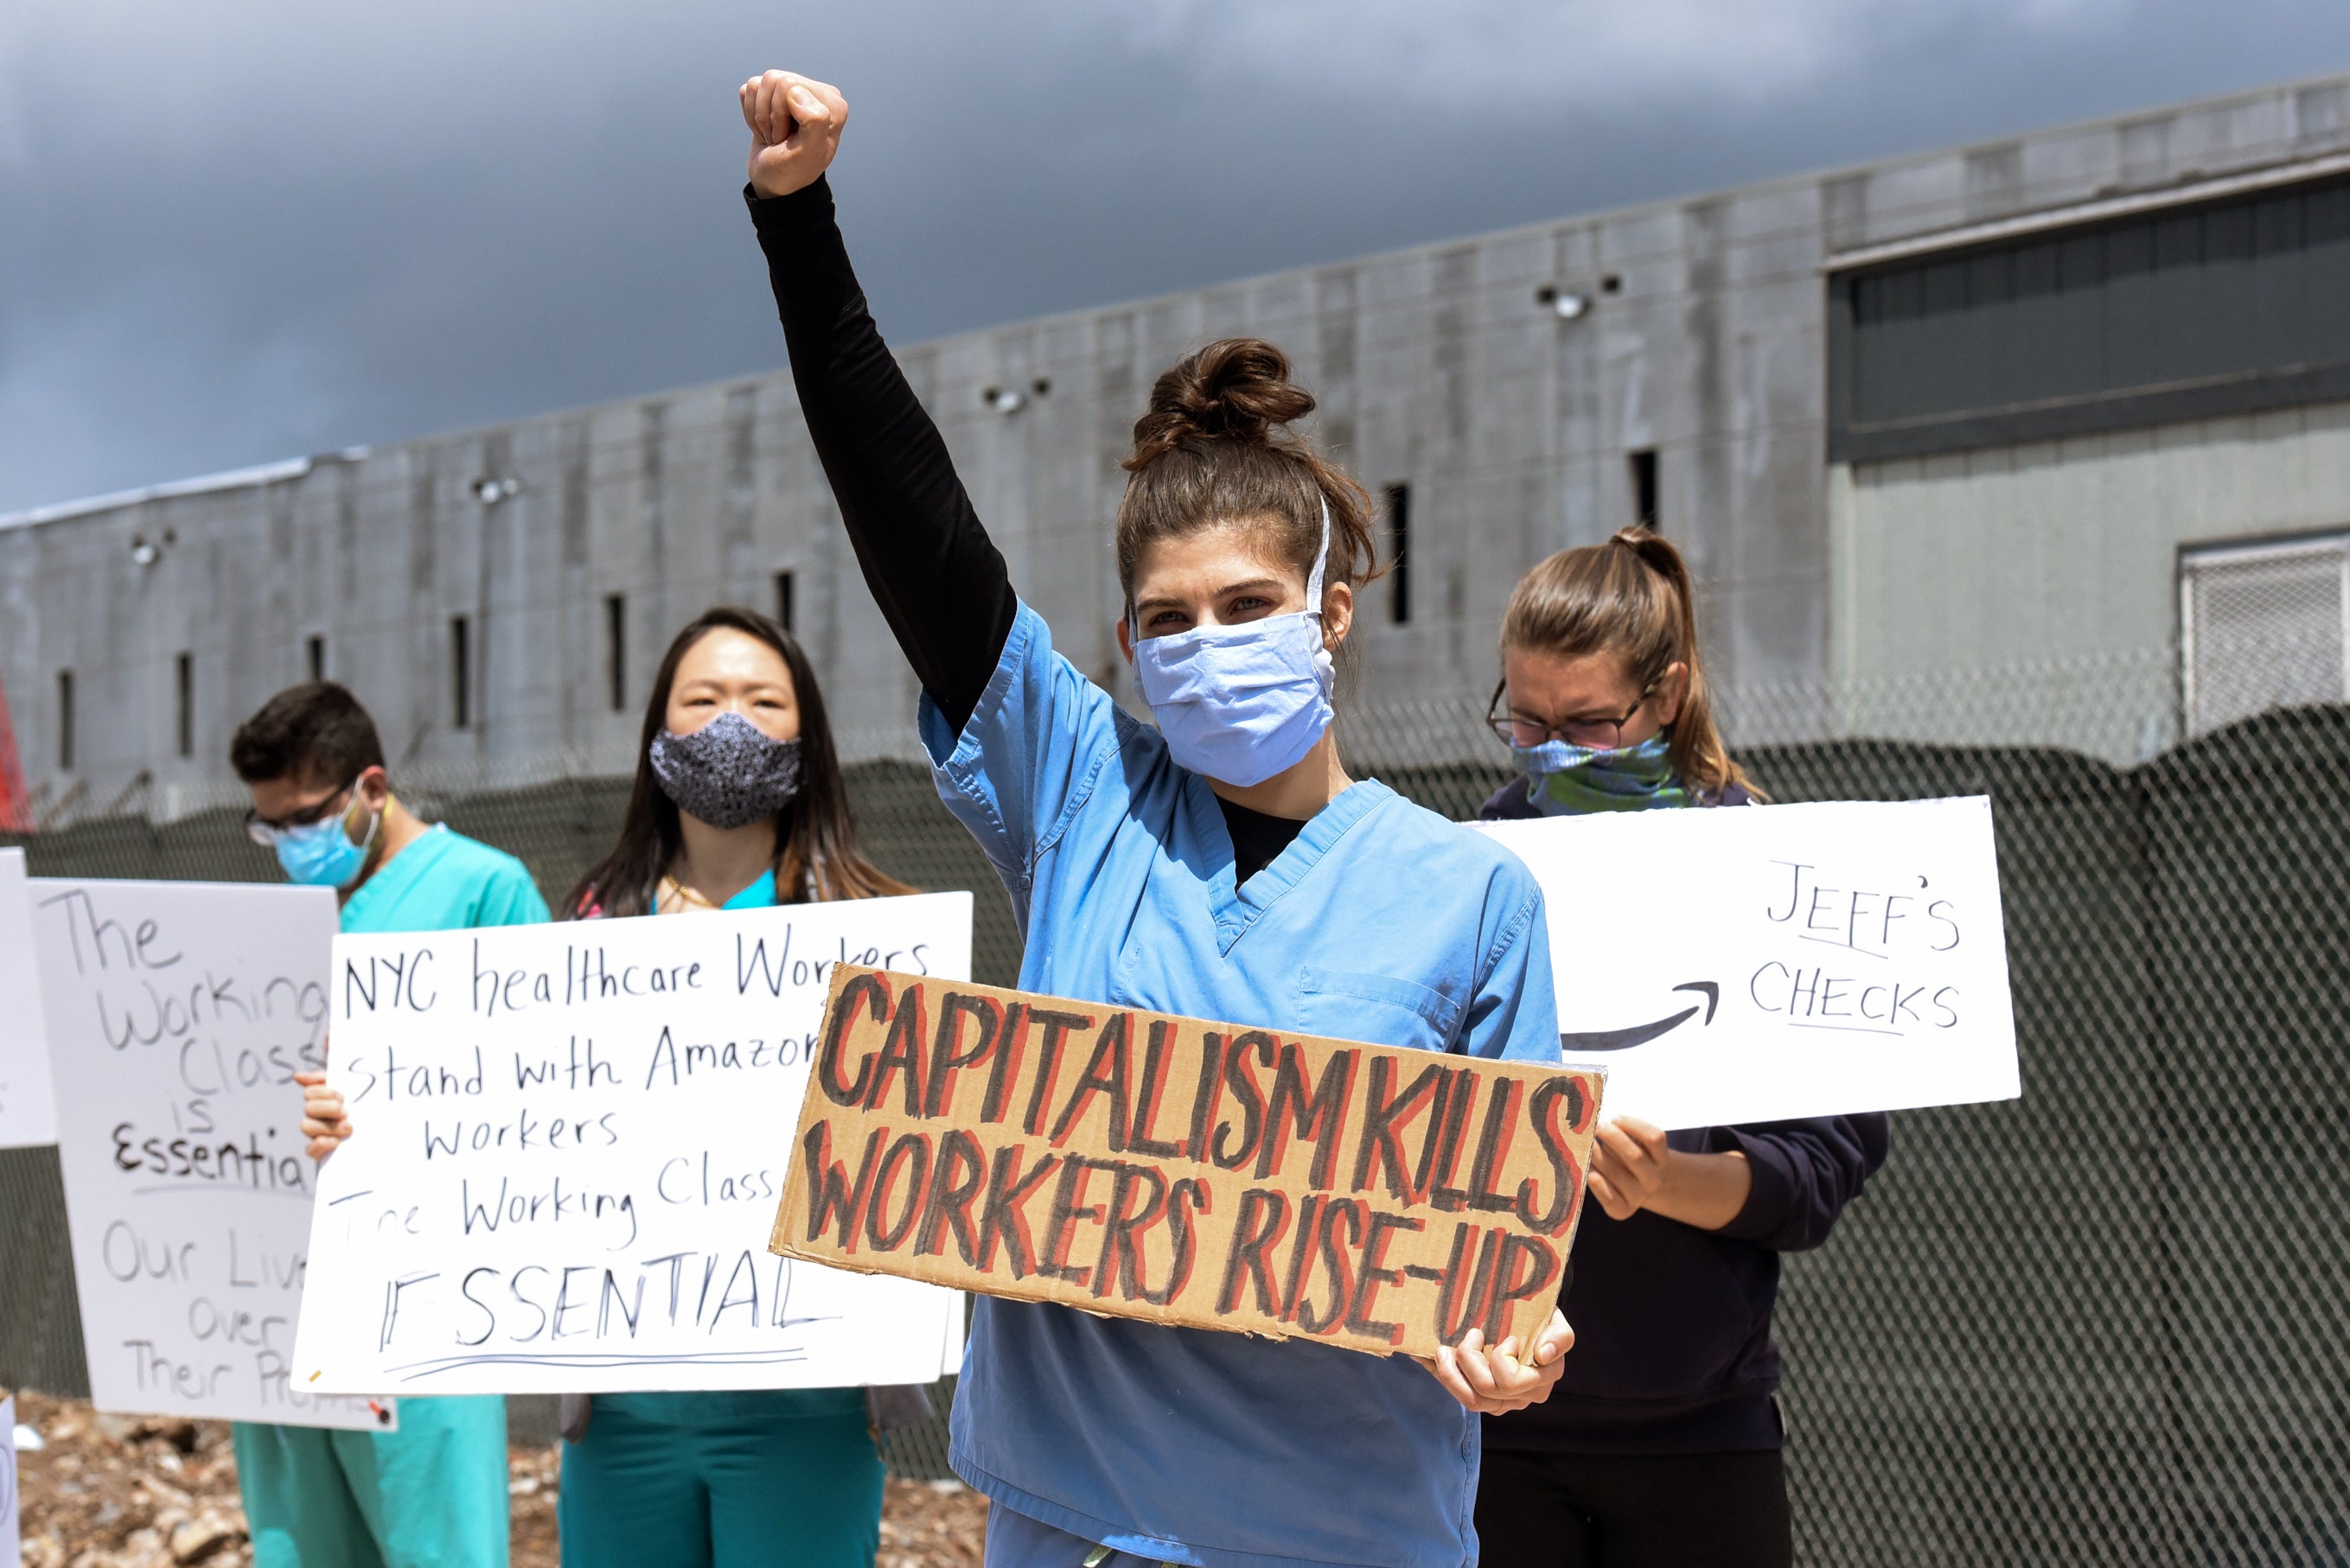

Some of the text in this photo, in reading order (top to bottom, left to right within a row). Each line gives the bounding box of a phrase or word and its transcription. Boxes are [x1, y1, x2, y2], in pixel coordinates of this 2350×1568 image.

[38, 889, 183, 977] The
[1767, 860, 1960, 952] JEFF'S
[346, 922, 931, 1019] NYC healthcare Workers
[1750, 961, 1960, 1029] CHECKS
[514, 1034, 623, 1091] with
[169, 1089, 215, 1134] is
[819, 971, 1579, 1239] CAPITALISM KILLS
[112, 1123, 321, 1191] Essentia
[463, 1176, 638, 1252] Working
[657, 1150, 774, 1207] Class
[804, 1119, 1212, 1306] WORKERS
[103, 1220, 308, 1290] Our Liv
[188, 1296, 288, 1347] Over
[123, 1340, 232, 1401] Their
